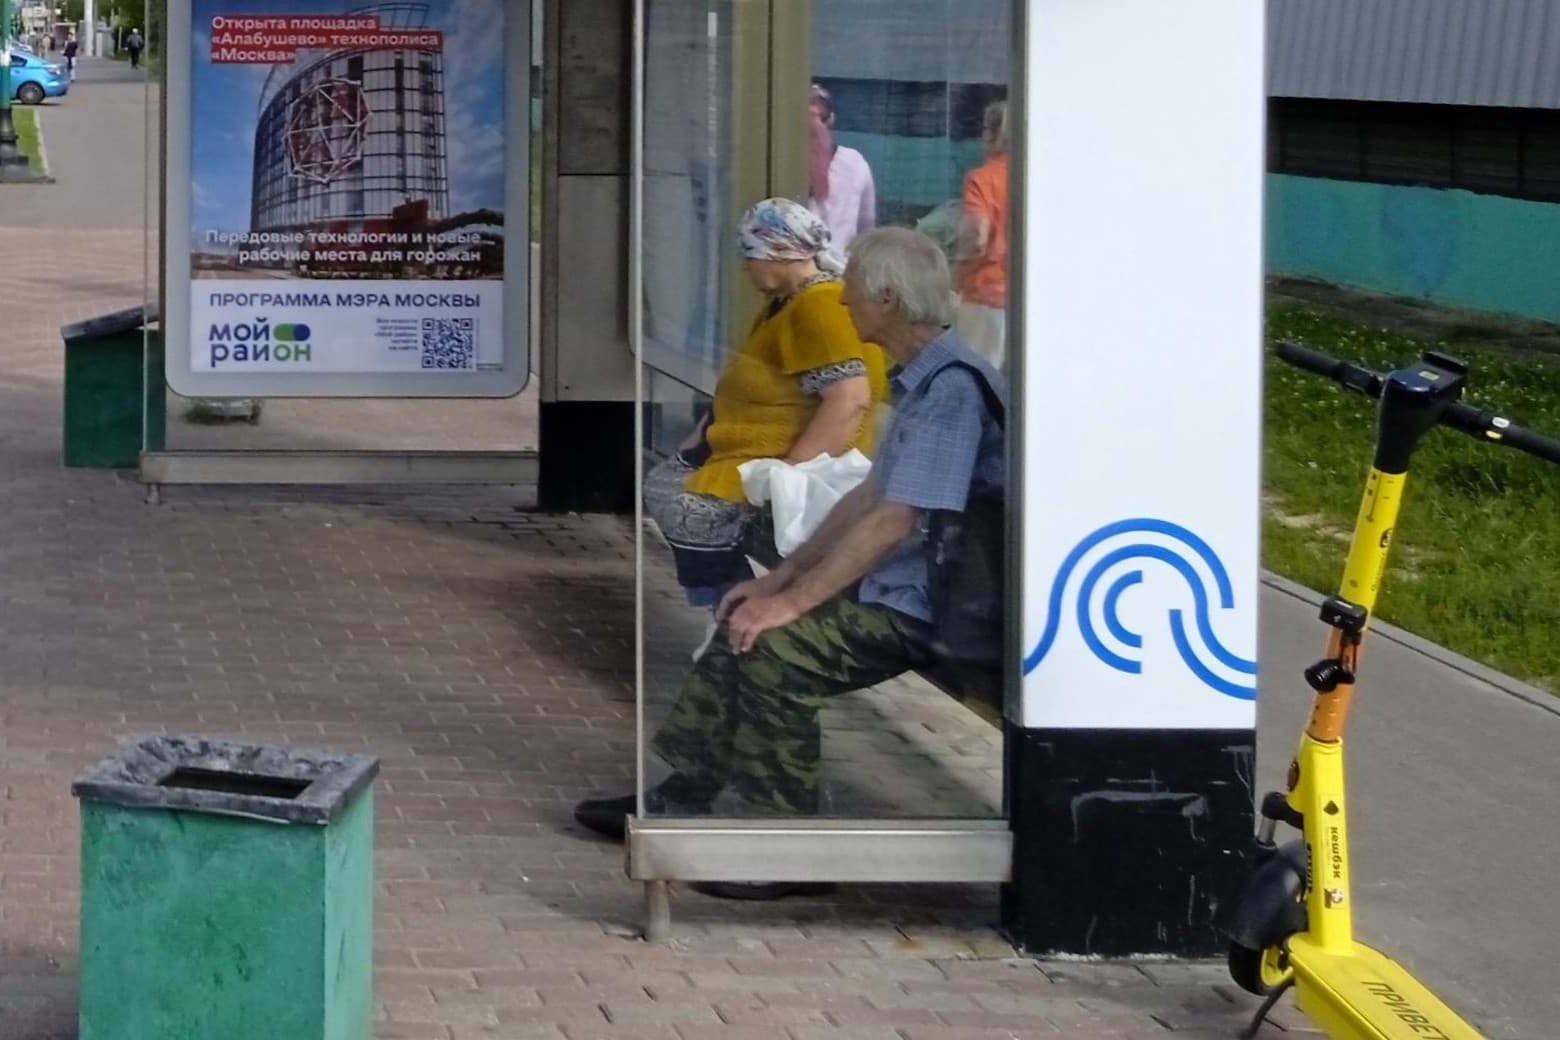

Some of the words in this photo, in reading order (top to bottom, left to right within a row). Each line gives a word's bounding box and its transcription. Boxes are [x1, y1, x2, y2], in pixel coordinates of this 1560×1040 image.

[211, 16, 287, 31] Открыта
[290, 17, 377, 33] площадка
[211, 32, 327, 48] «Алабушево»
[330, 33, 439, 46] технополиса
[211, 48, 295, 61] «Москва»
[206, 229, 305, 247] Передовые
[308, 231, 409, 245] технологии
[412, 232, 423, 244] и
[426, 232, 481, 245] новые
[239, 249, 310, 266] рабочие
[314, 250, 370, 263] места
[370, 250, 403, 265] для
[405, 250, 481, 266] горожан
[209, 293, 332, 308] ПРОГРАММА
[335, 293, 390, 307] МЭРА
[394, 293, 481, 308] МОСКВЫ
[208, 317, 270, 342] мой
[1330, 826, 1343, 879] кешбэк
